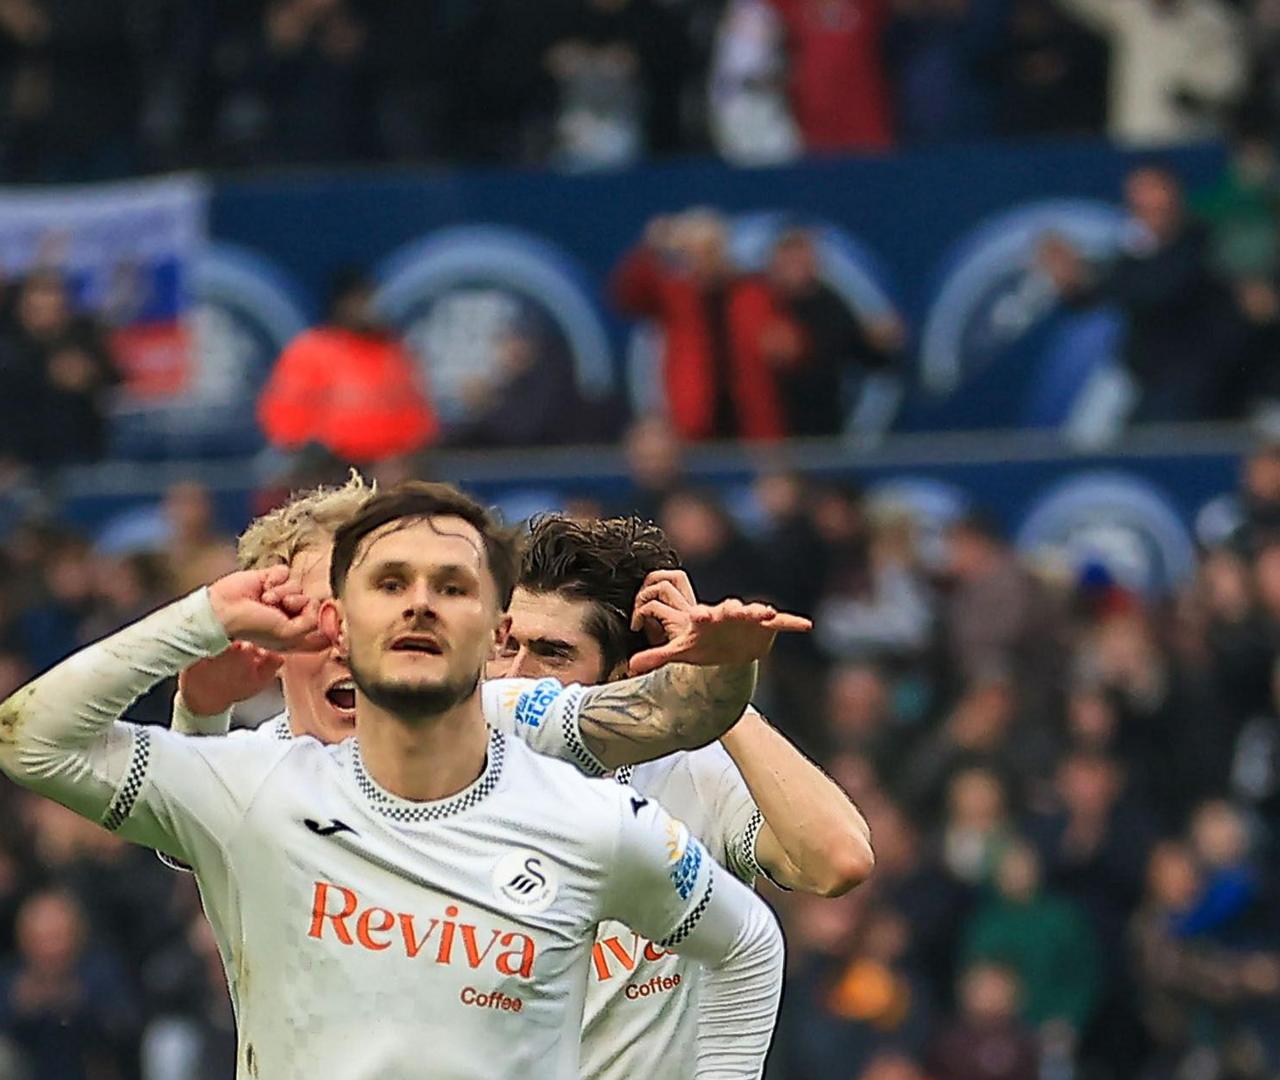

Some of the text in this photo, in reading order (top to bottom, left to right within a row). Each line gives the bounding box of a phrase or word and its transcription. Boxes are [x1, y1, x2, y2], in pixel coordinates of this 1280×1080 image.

[308, 882, 535, 979] Reviva
[460, 986, 524, 1013] Coffee
[624, 973, 681, 1000] Coffee
